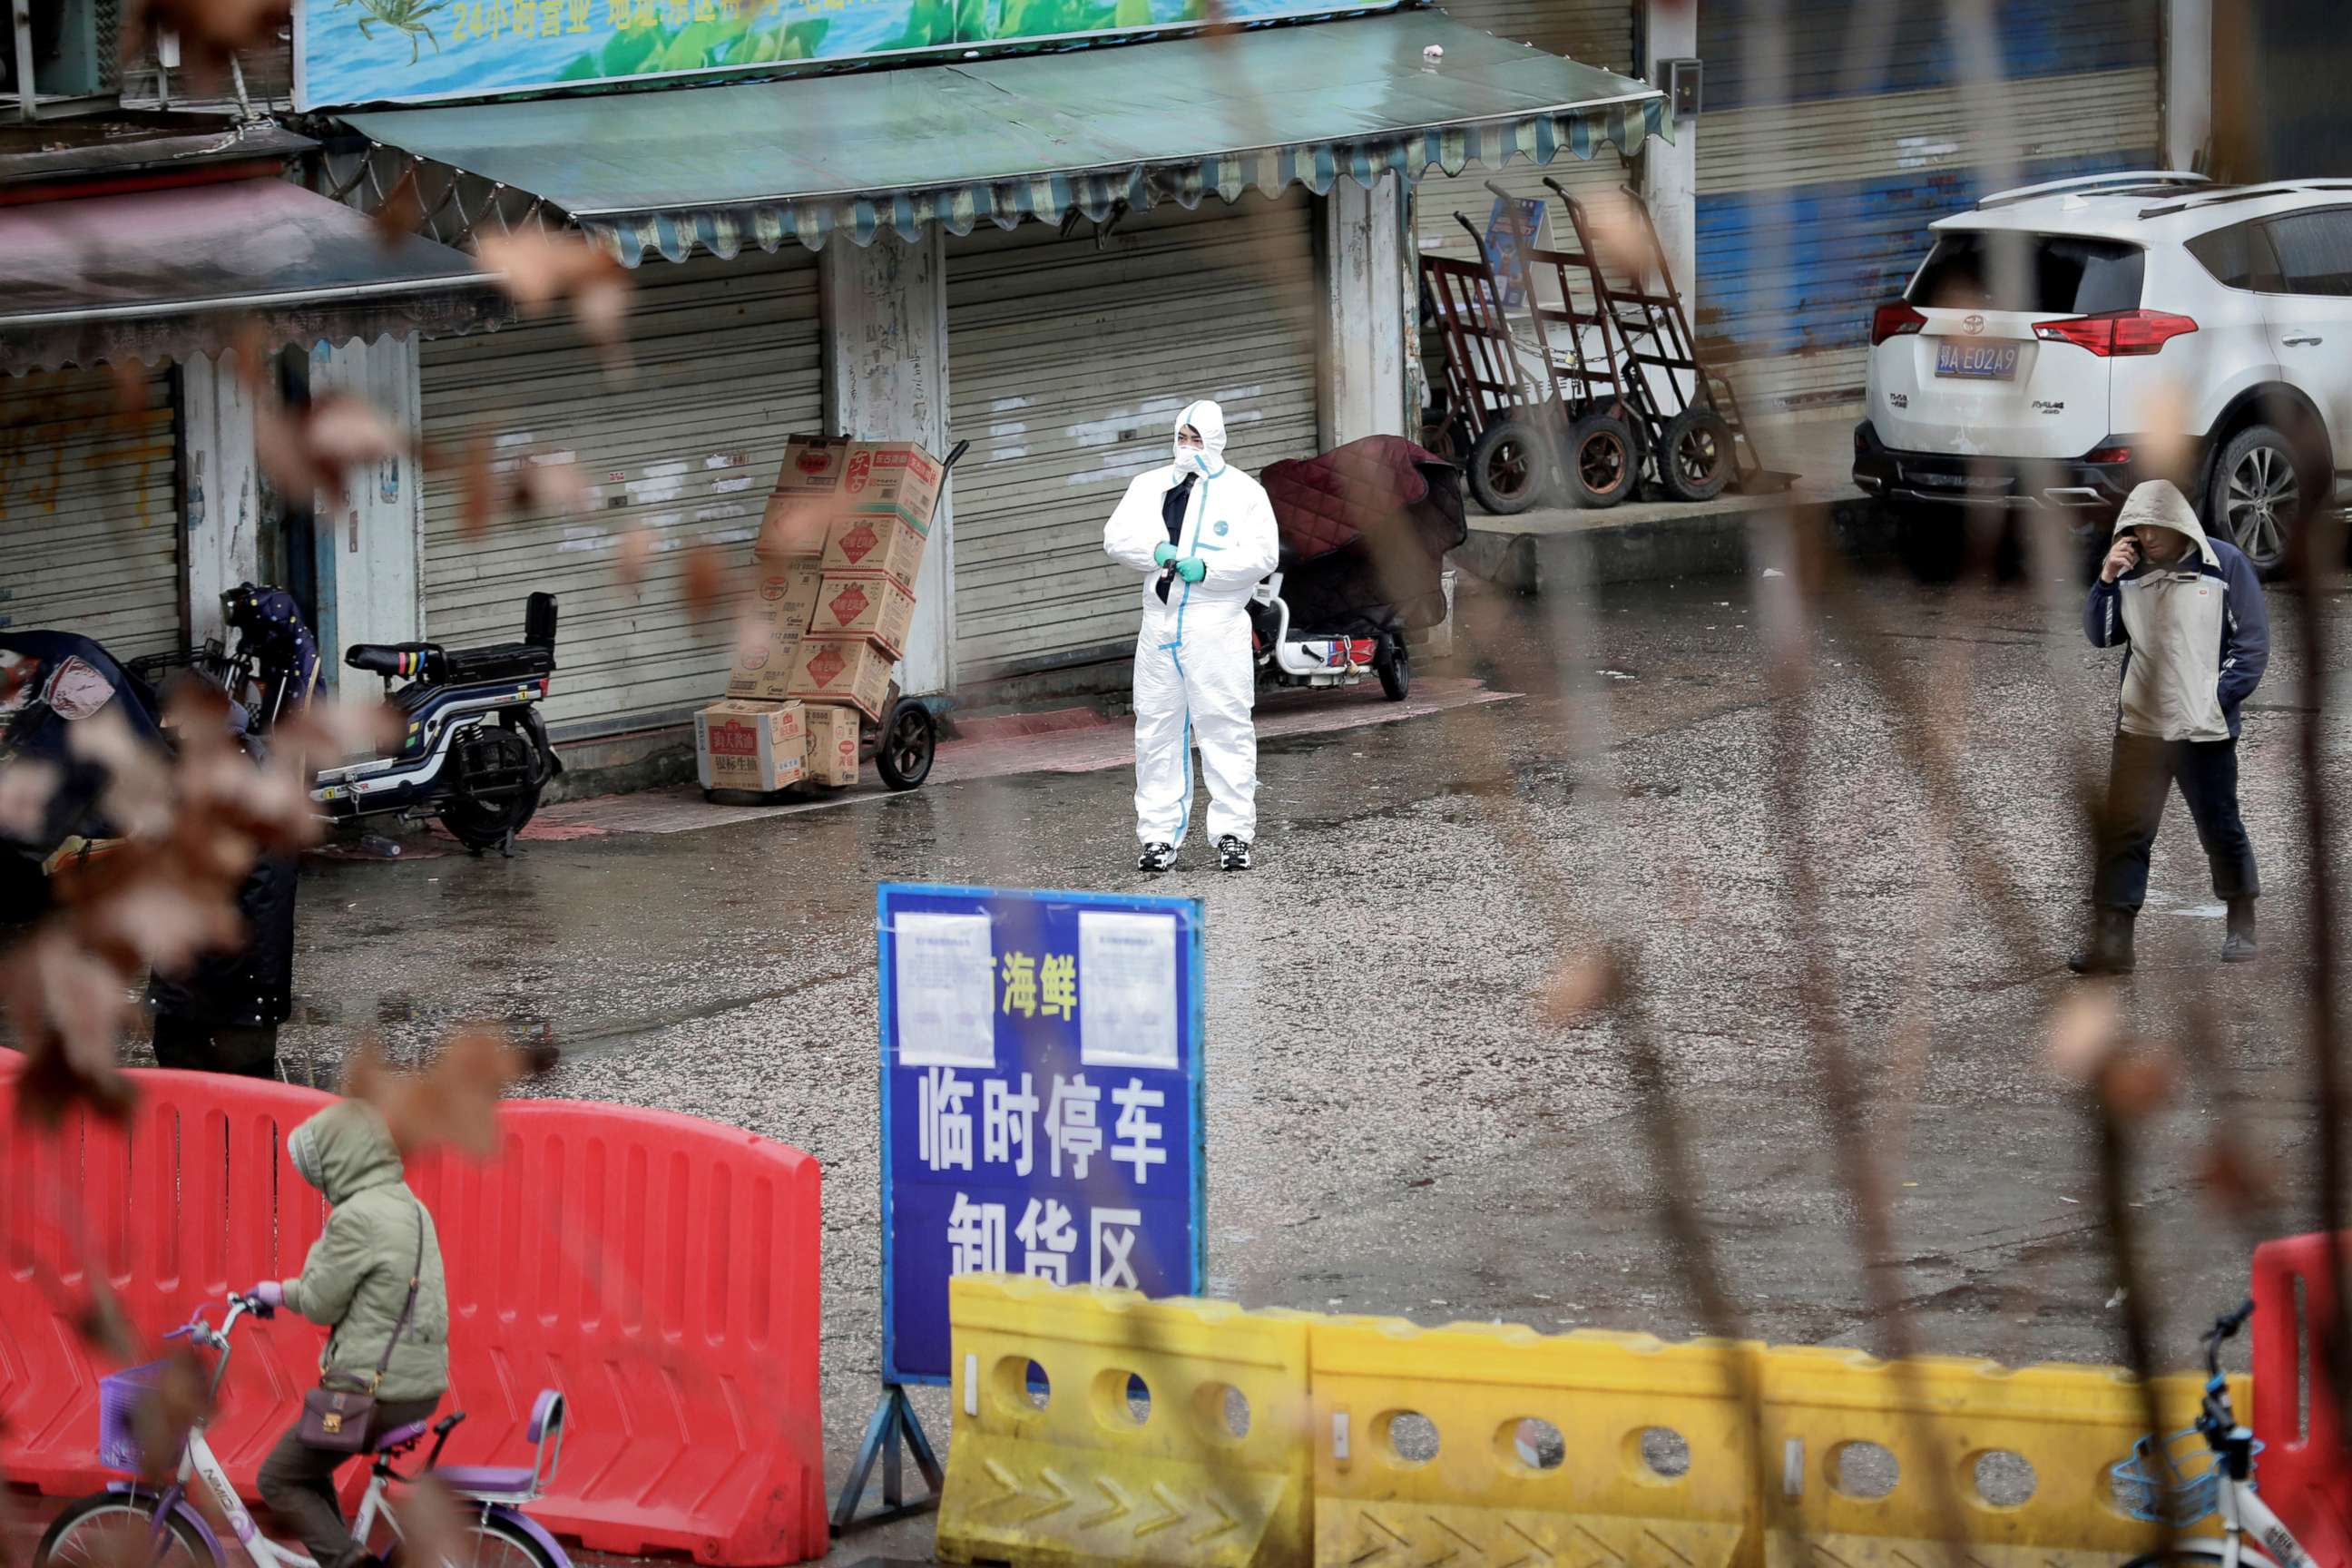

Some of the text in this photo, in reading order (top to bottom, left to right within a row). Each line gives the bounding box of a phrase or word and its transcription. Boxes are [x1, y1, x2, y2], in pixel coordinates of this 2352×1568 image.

[990, 950, 1078, 1022] 海鲜
[917, 1065, 1167, 1185] 临时停车
[946, 1191, 1142, 1290] 卸货区
